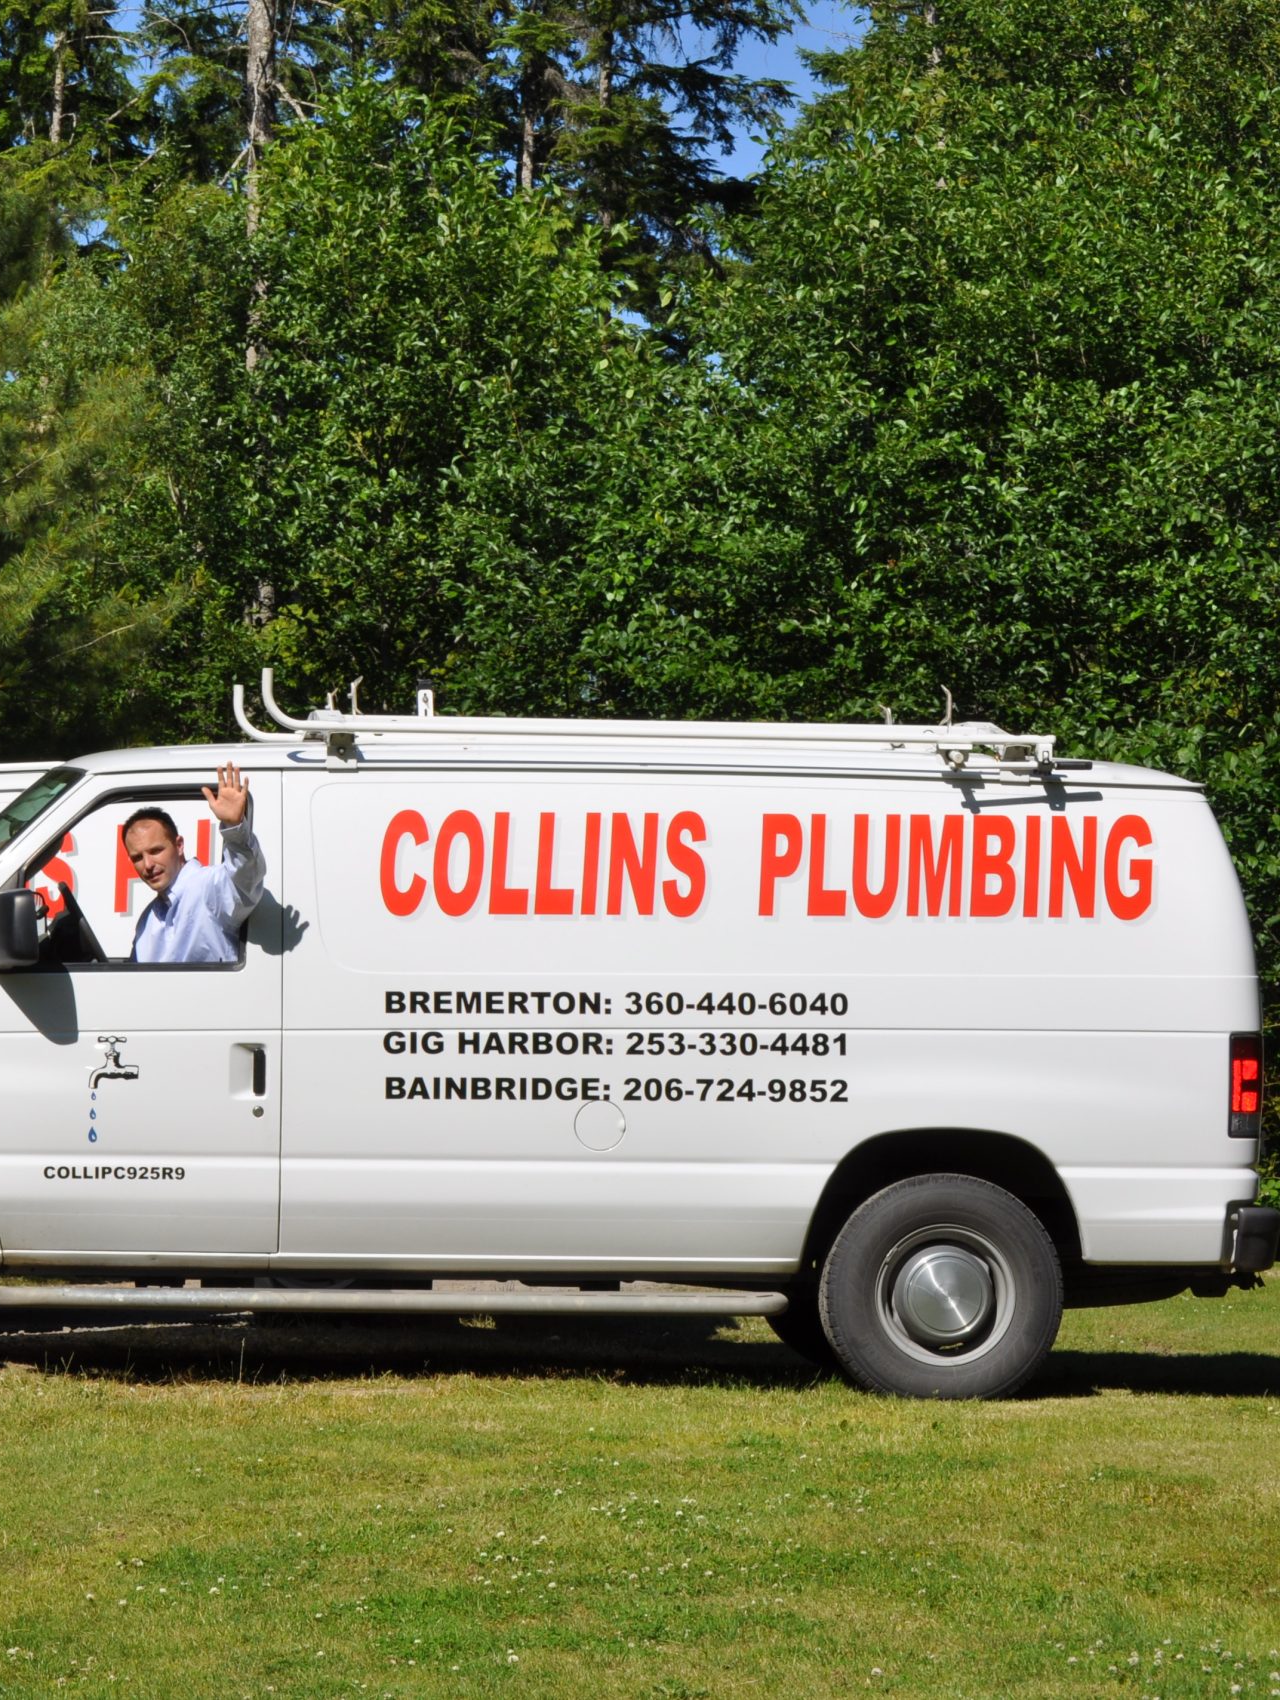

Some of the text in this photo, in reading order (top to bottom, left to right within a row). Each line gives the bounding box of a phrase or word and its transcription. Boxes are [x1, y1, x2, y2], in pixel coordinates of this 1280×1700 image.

[380, 810, 1154, 921] COLLINS PLUMBING
[385, 991, 848, 1016] BREMERTON: 360-440-6040
[383, 1031, 846, 1057] GIG HARBOR: 253-330-4481
[385, 1076, 848, 1103] BAINBRIDGE: 206-724-9852
[43, 1166, 186, 1180] COLLIPC925R9
